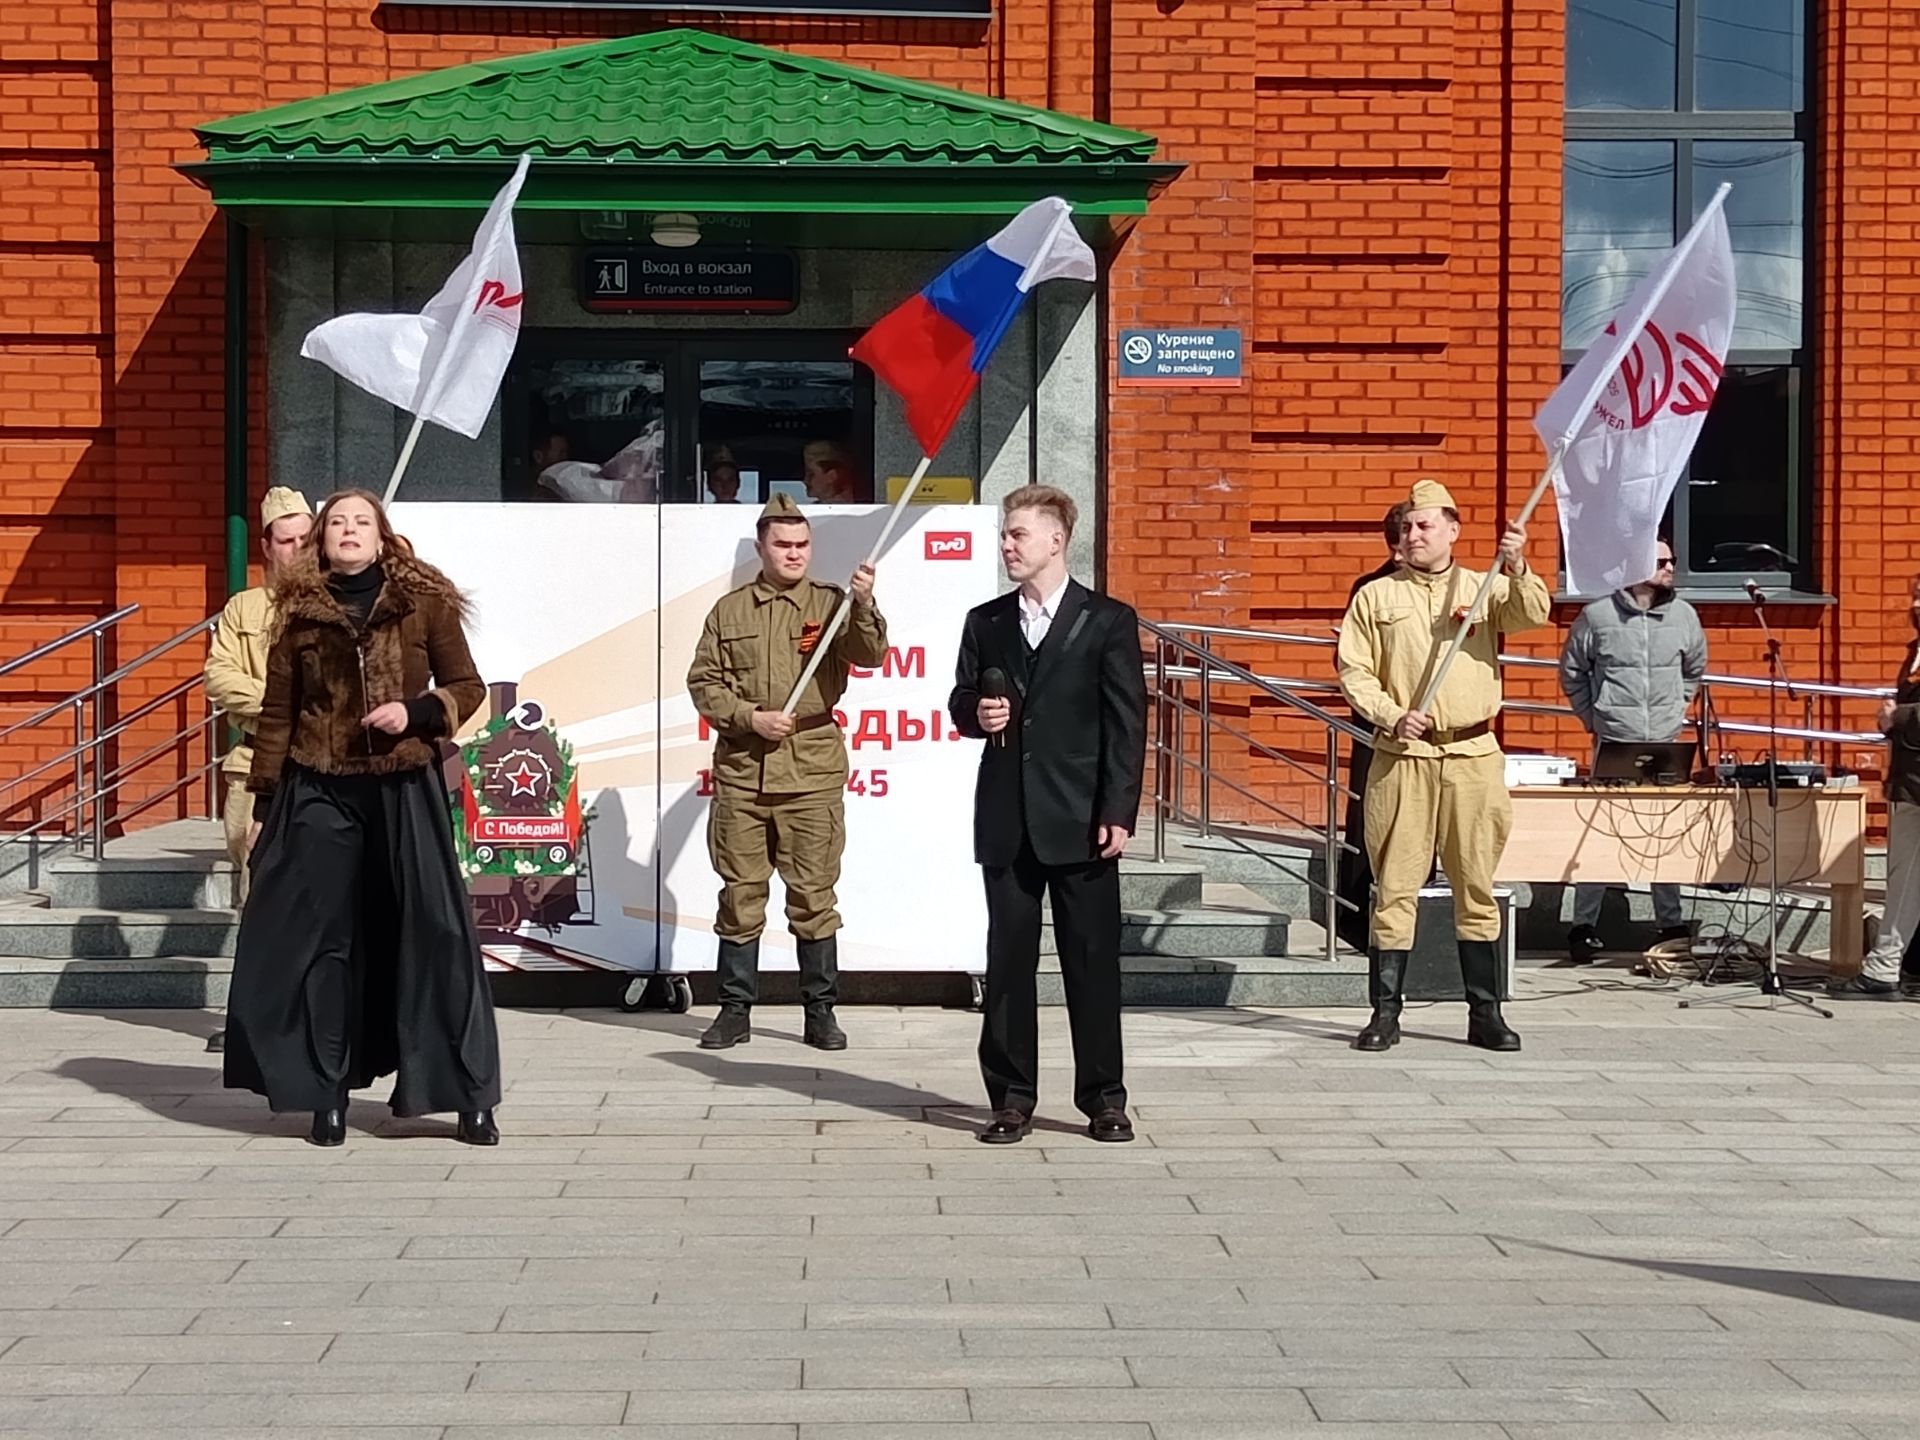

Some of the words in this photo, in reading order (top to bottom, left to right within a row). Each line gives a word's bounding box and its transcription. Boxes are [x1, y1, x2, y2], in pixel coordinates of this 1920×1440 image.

[642, 260, 680, 276] Вход
[685, 264, 694, 274] в
[698, 263, 752, 275] вокзал
[644, 283, 694, 295] Entrance
[698, 284, 710, 295] to
[713, 283, 753, 295] station
[1157, 333, 1215, 348] Курение
[1157, 349, 1236, 362] запрещено
[1157, 364, 1171, 373] No
[1173, 363, 1214, 376] smoking
[485, 822, 495, 835] С
[499, 822, 564, 837] Победой!
